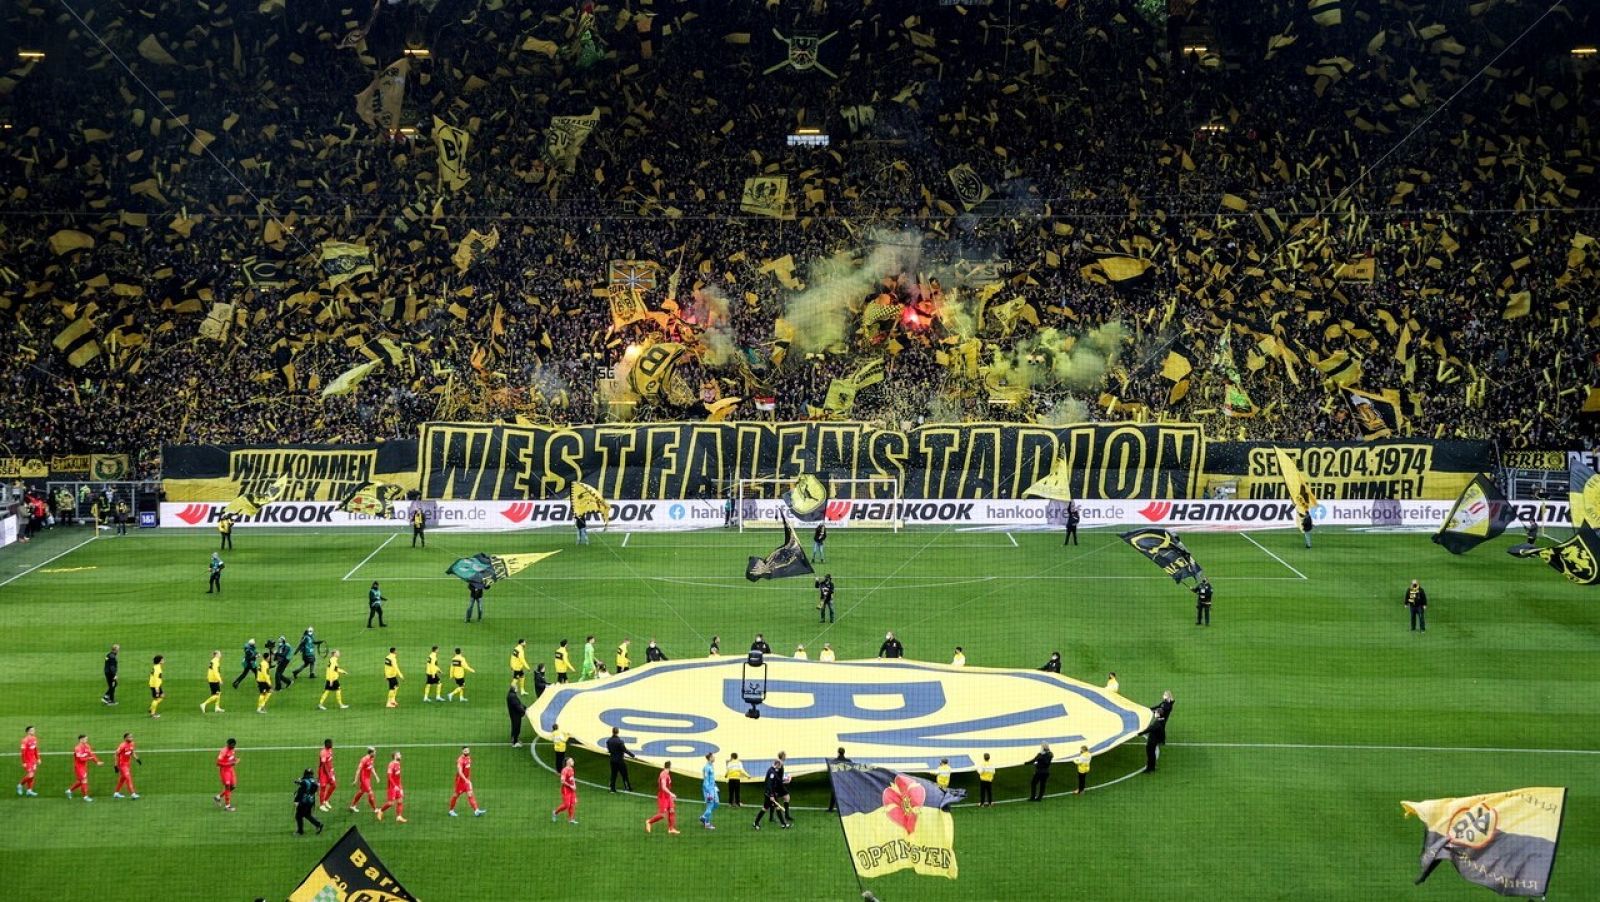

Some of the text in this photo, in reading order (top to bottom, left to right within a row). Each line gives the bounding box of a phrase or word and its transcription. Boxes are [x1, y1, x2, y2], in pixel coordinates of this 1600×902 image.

[231, 452, 374, 483] WILLKOMMEN
[1252, 446, 1428, 479] SE 02.04.1974
[1303, 481, 1337, 501] ÜR
[986, 505, 1124, 519] hankookrefen.de
